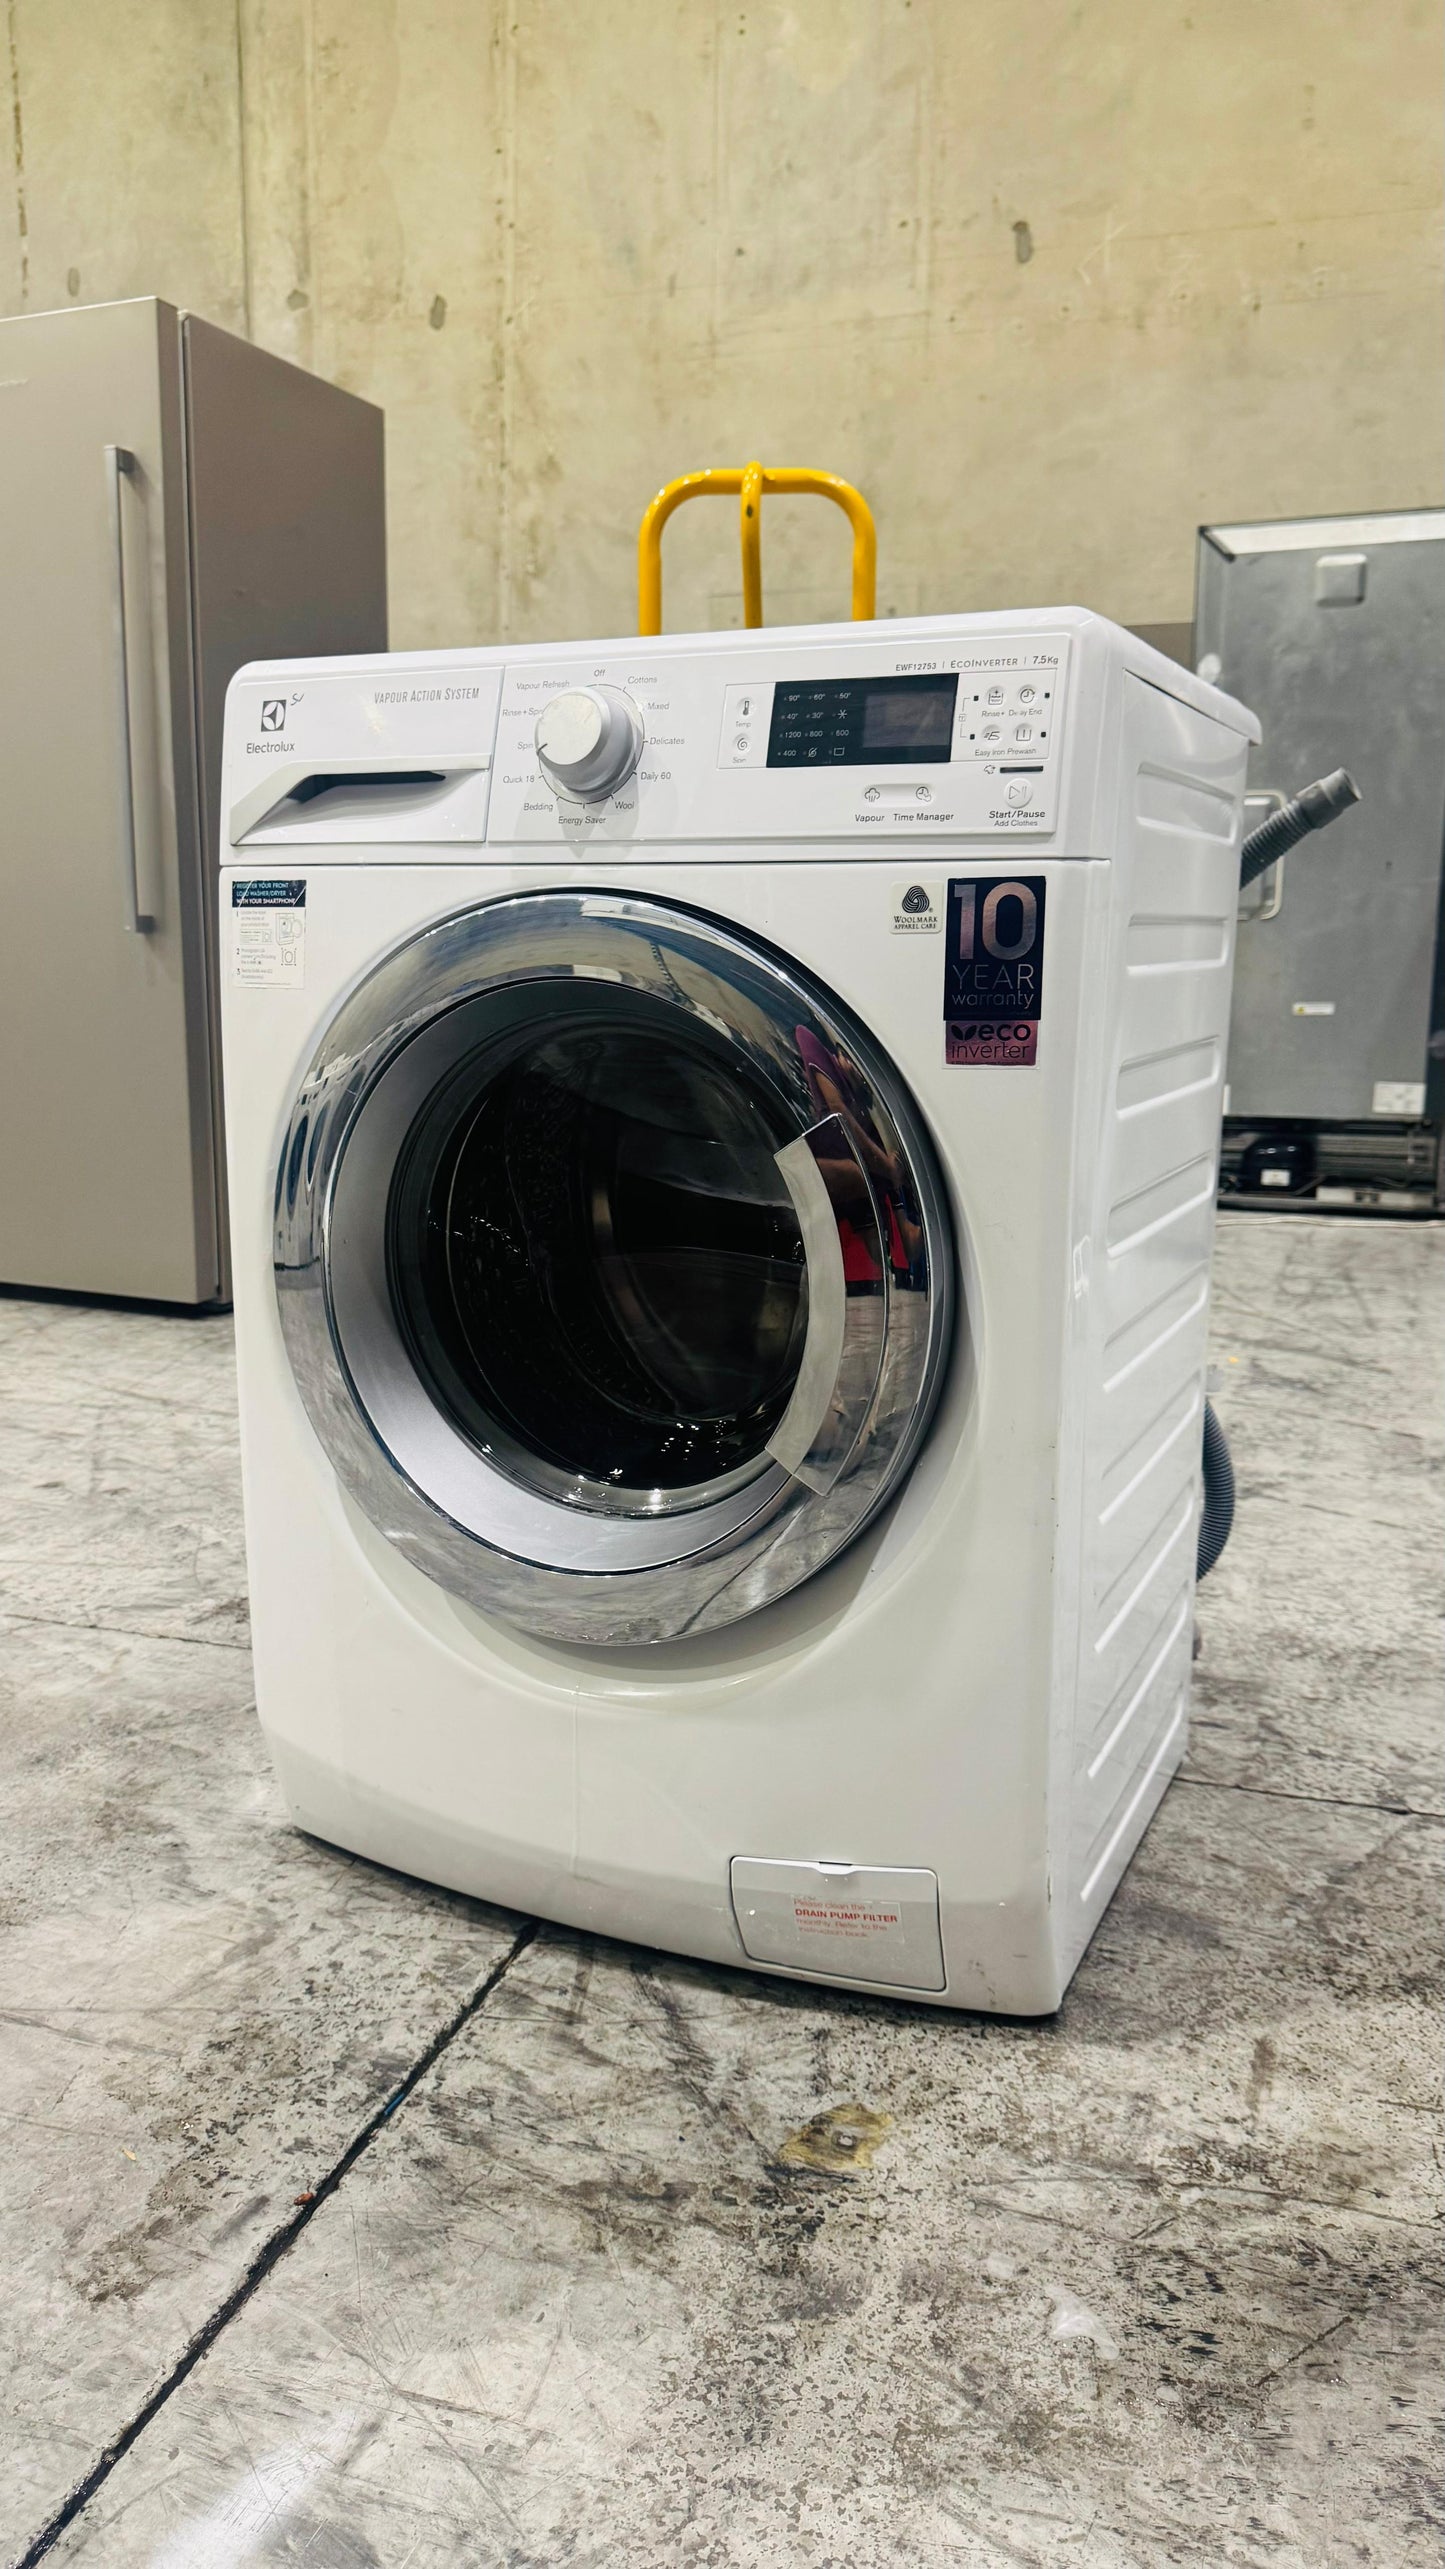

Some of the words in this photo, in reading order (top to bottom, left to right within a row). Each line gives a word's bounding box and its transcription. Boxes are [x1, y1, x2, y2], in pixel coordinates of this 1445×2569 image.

[594, 669, 605, 677] Off
[627, 675, 658, 685] Cottons
[516, 682, 541, 691] Vapour
[374, 692, 408, 704] VAPOUR
[410, 690, 442, 702] ACTION
[444, 687, 479, 700] SYSTEM
[648, 702, 670, 711] Mixed
[650, 736, 685, 746] Delicates
[246, 742, 296, 755] Electrolux
[502, 774, 523, 784] Quick
[525, 775, 535, 783] 18
[640, 771, 659, 781] Daily
[660, 771, 672, 780] 60
[523, 802, 554, 813] Bedding
[615, 801, 635, 810] Wool
[854, 813, 885, 823] Vapour
[893, 812, 915, 821] Time
[916, 812, 955, 823] Manager
[989, 810, 1046, 819] Start/Pause
[558, 815, 584, 827] Energy
[585, 815, 606, 825] Saver
[893, 915, 938, 924] WOOLMARK
[954, 882, 1037, 960] 10
[952, 964, 1035, 990] YEAR
[952, 990, 1034, 1009] warranty
[978, 1024, 1032, 1042] eco
[951, 1042, 1031, 1059] inverter
[795, 1908, 827, 1918] DRAIN
[829, 1911, 861, 1920] PUMP
[862, 1913, 898, 1923] FILTER
